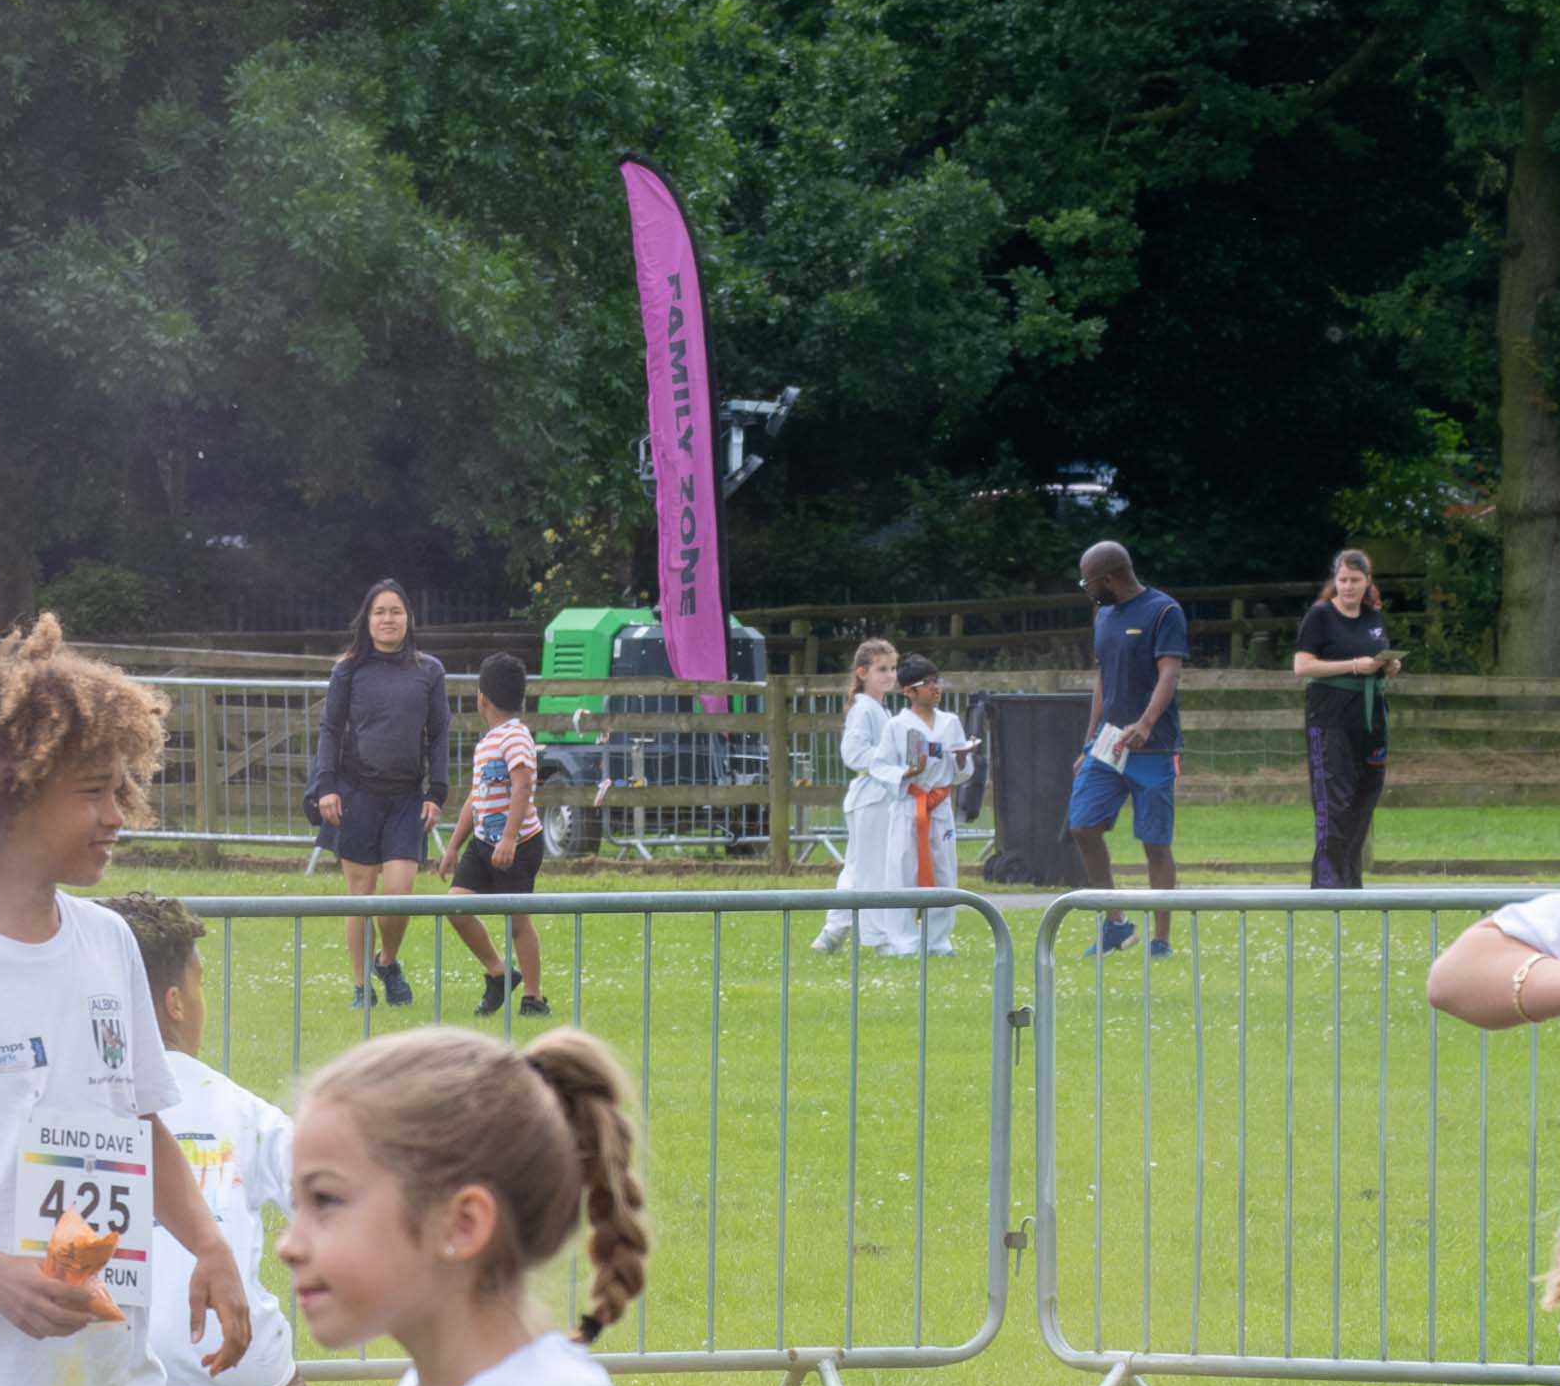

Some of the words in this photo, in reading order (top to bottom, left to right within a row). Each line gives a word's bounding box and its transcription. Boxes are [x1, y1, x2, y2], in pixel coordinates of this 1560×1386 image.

[666, 273, 694, 459] FAMILY
[679, 474, 701, 617] ZONE
[40, 1127, 91, 1148] BLIND
[95, 1129, 133, 1154] DAVE
[39, 1179, 131, 1236] 425
[104, 1267, 138, 1288] RUN
